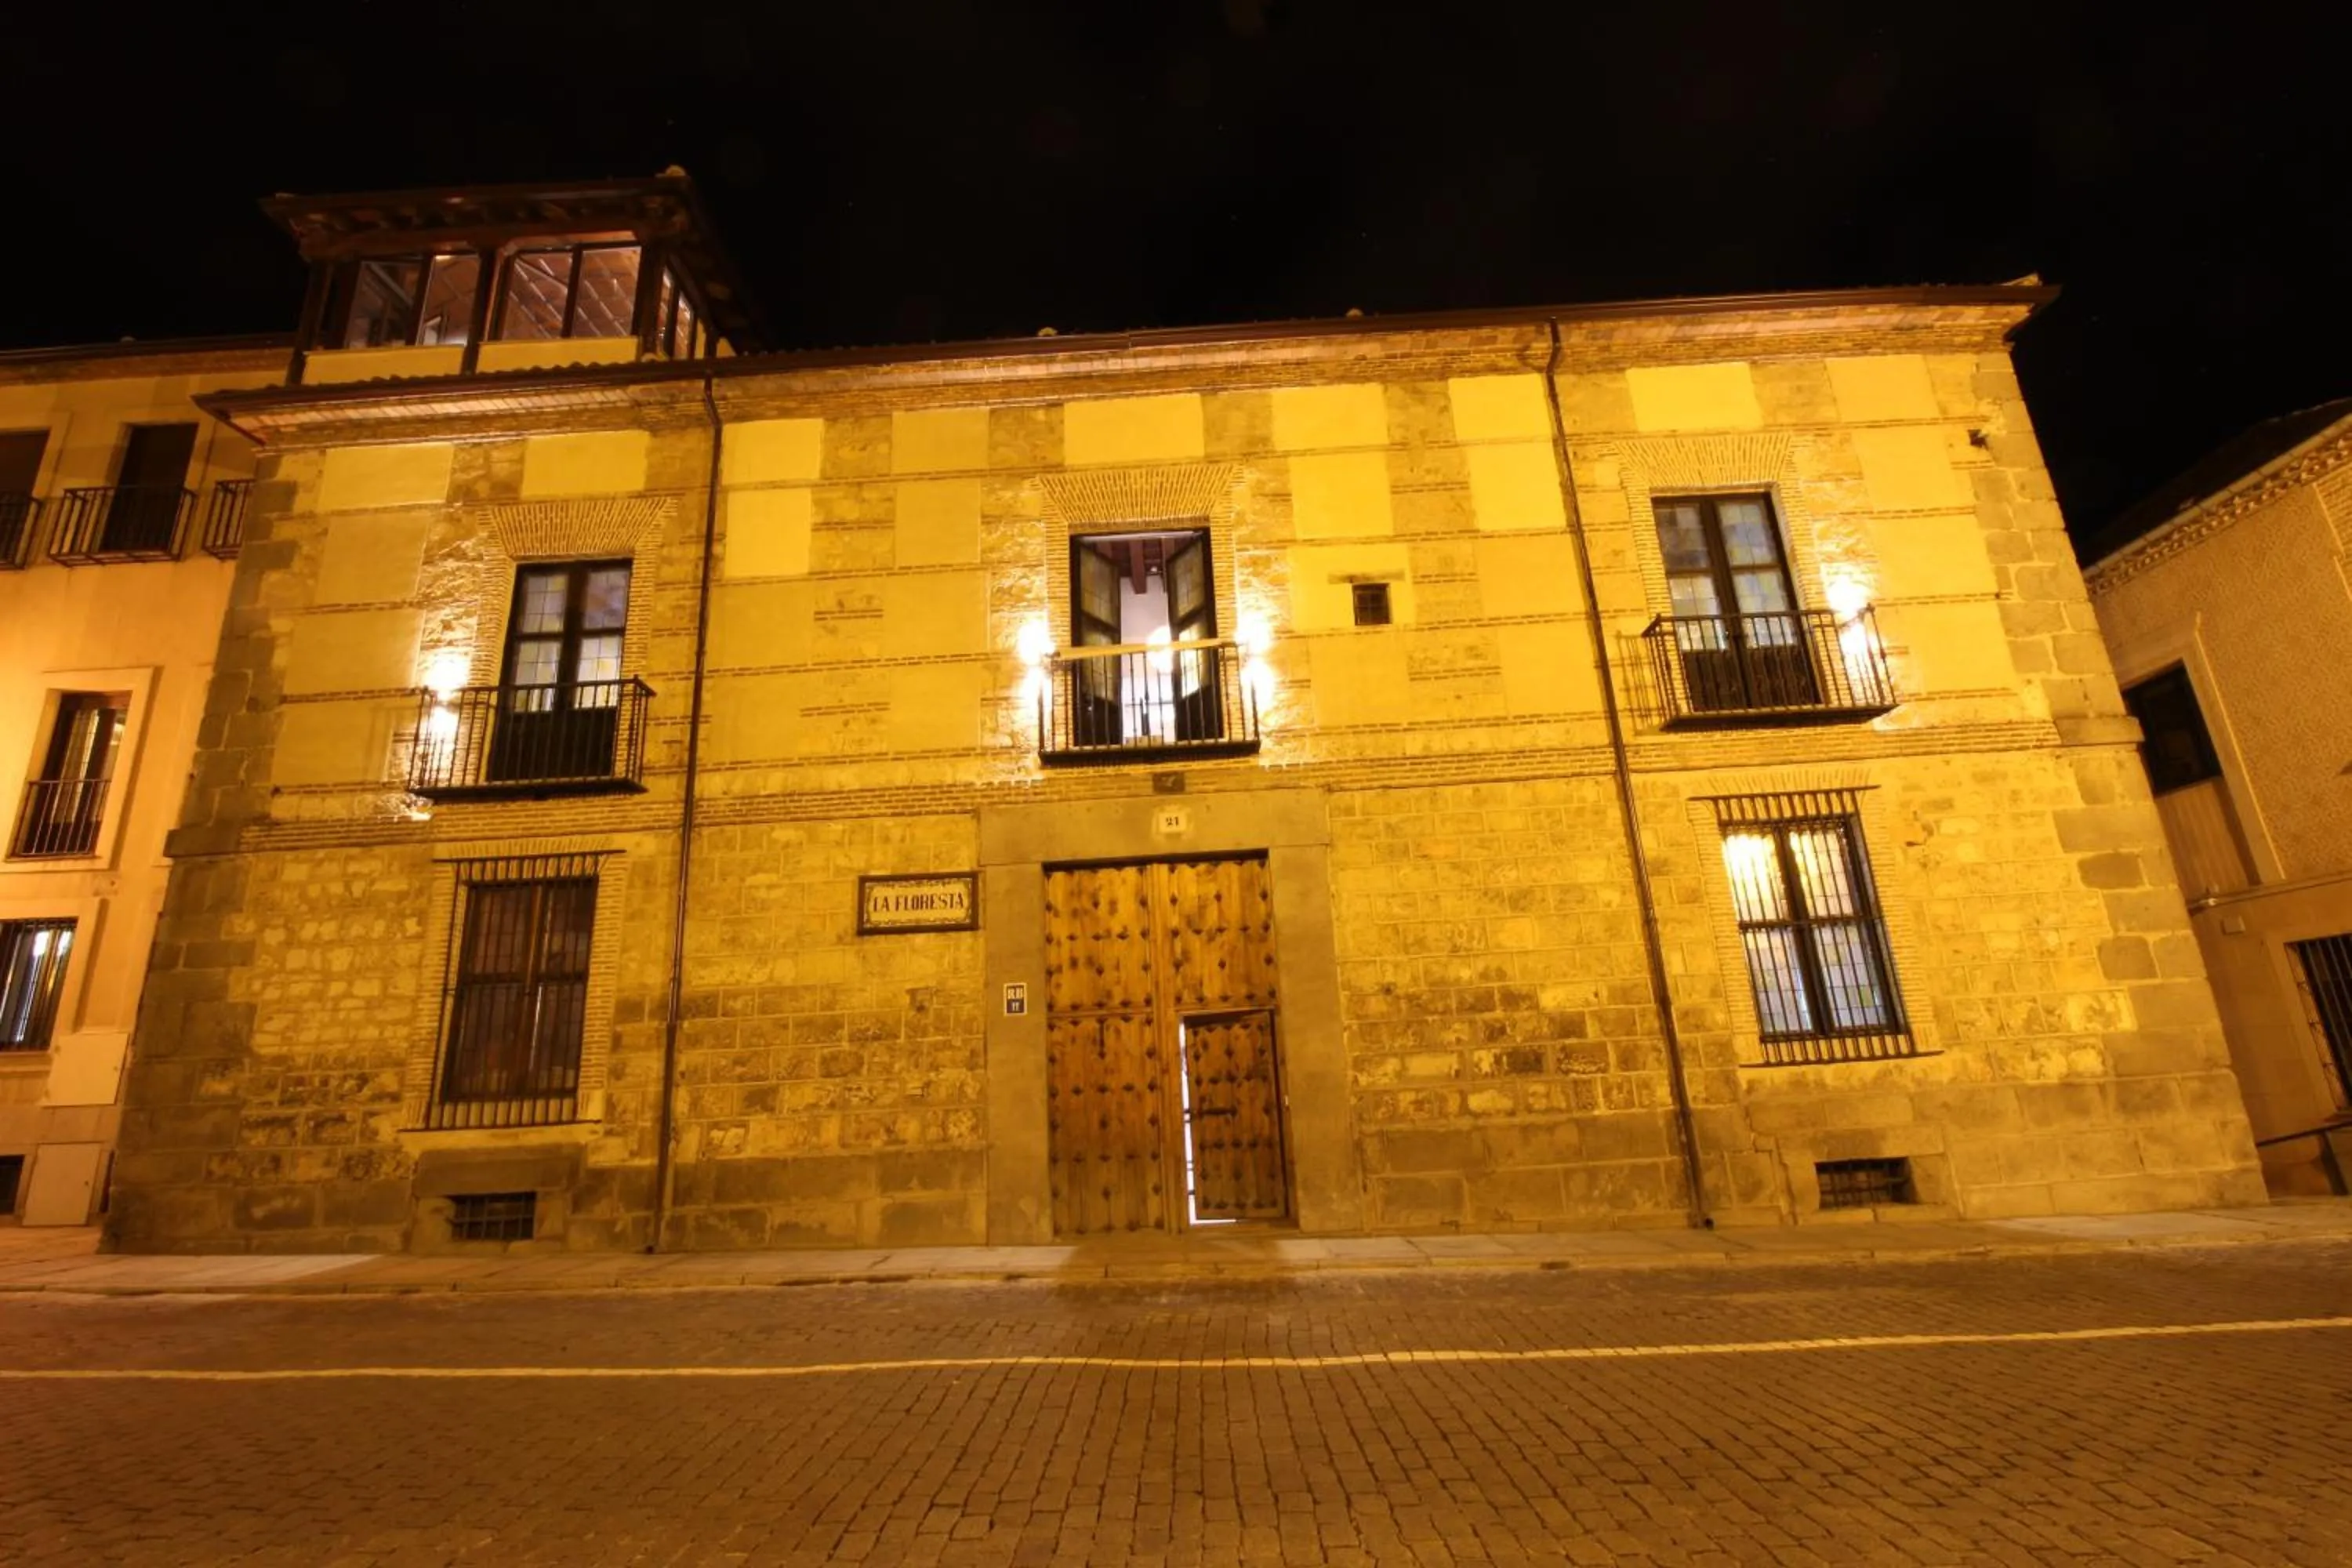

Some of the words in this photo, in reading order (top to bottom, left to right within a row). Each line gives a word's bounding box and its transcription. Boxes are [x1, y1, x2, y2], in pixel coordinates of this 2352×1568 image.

[1165, 816, 1179, 827] 21
[873, 895, 891, 912] LA
[895, 891, 964, 912] FLORESTA
